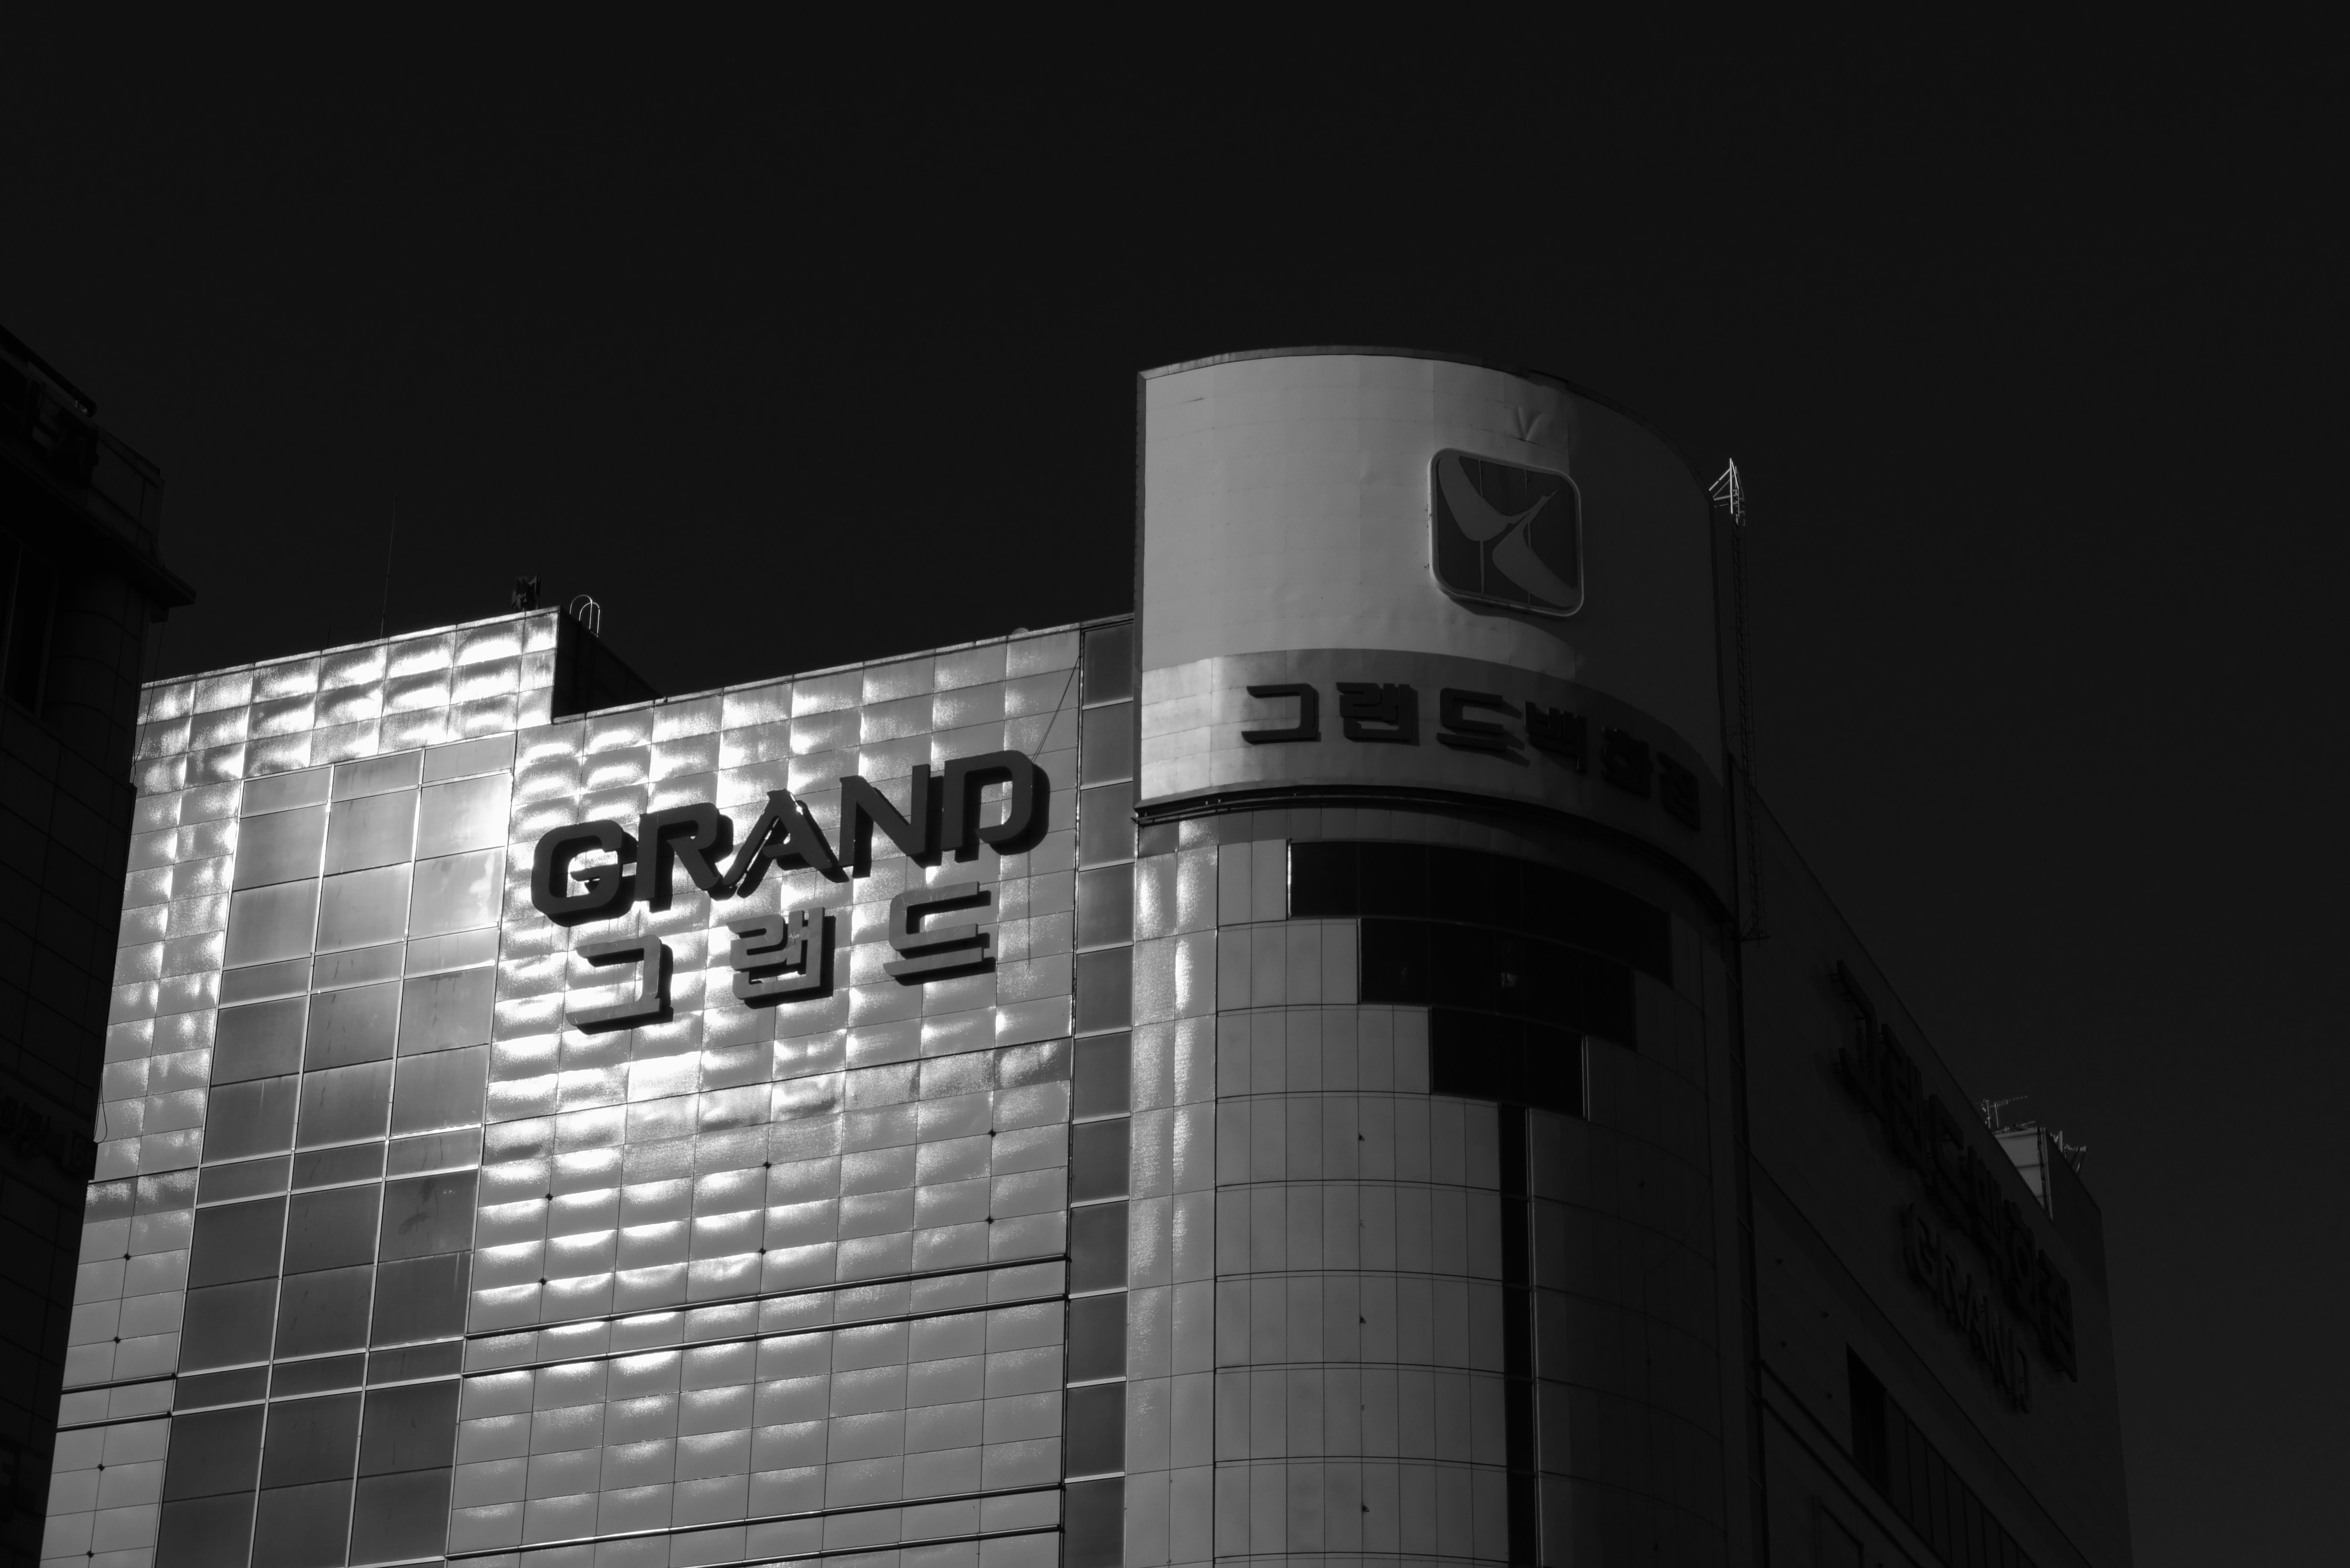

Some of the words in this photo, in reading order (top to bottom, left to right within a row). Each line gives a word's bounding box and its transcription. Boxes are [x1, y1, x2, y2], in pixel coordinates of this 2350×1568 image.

[531, 750, 1035, 915] GRAND
[1241, 682, 1701, 832] 그랜드백화점
[566, 882, 987, 1027] 그랜드
[1836, 959, 2078, 1382] 그랜드백화점
[1907, 1202, 2033, 1415] GRAND
